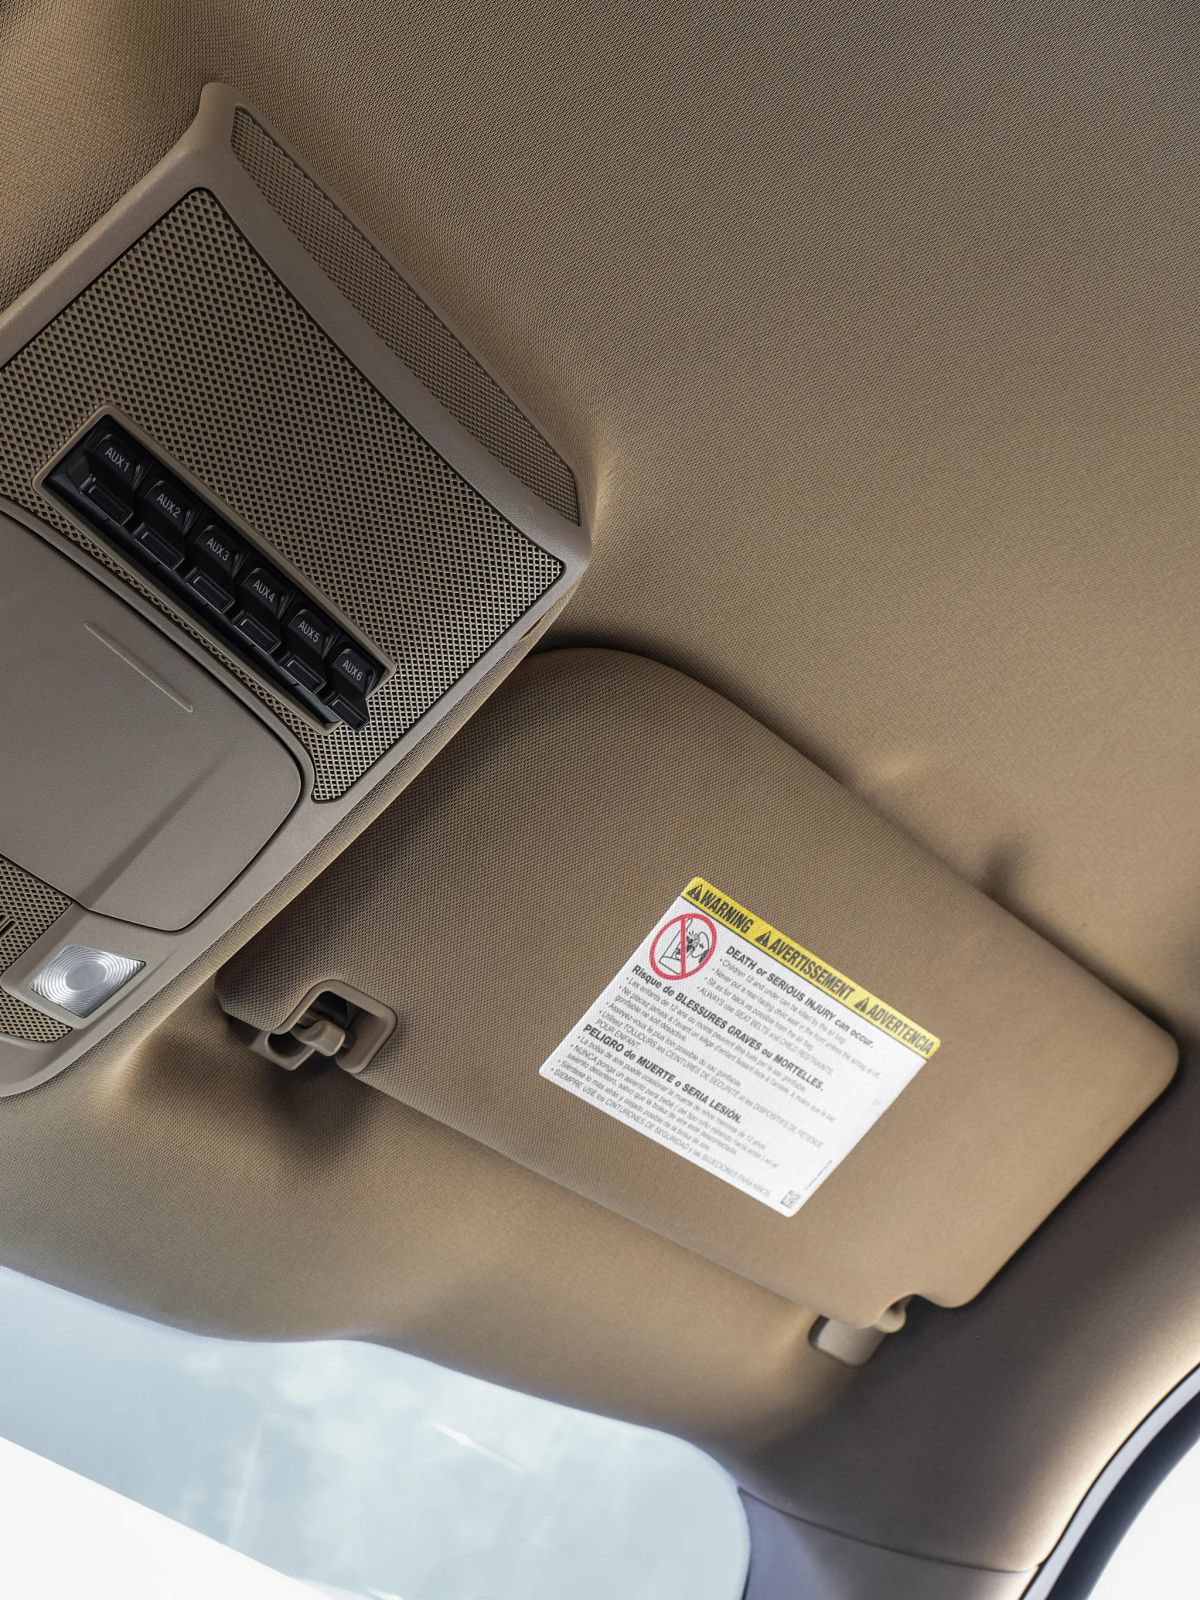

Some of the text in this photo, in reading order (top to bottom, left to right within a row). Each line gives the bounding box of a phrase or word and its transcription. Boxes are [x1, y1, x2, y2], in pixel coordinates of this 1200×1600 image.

[632, 964, 662, 988] Risque
[662, 985, 675, 997] de
[675, 992, 728, 1029] BLESSURES
[727, 1025, 762, 1050] GRAVES
[761, 1048, 773, 1058] ou
[773, 1054, 822, 1090] MORTELLES.
[700, 890, 753, 933] WARNING
[768, 939, 854, 999] AVERTISSEMENT
[866, 1004, 934, 1054] ADVERTENCIA
[726, 946, 873, 1048] DEATH or SERIOUS INJURY can occur.
[583, 1024, 624, 1052] PELIGRO
[623, 1050, 636, 1060] de
[636, 1056, 676, 1083] MUERTE
[674, 1080, 682, 1088] o
[681, 1083, 709, 1104] SERIA
